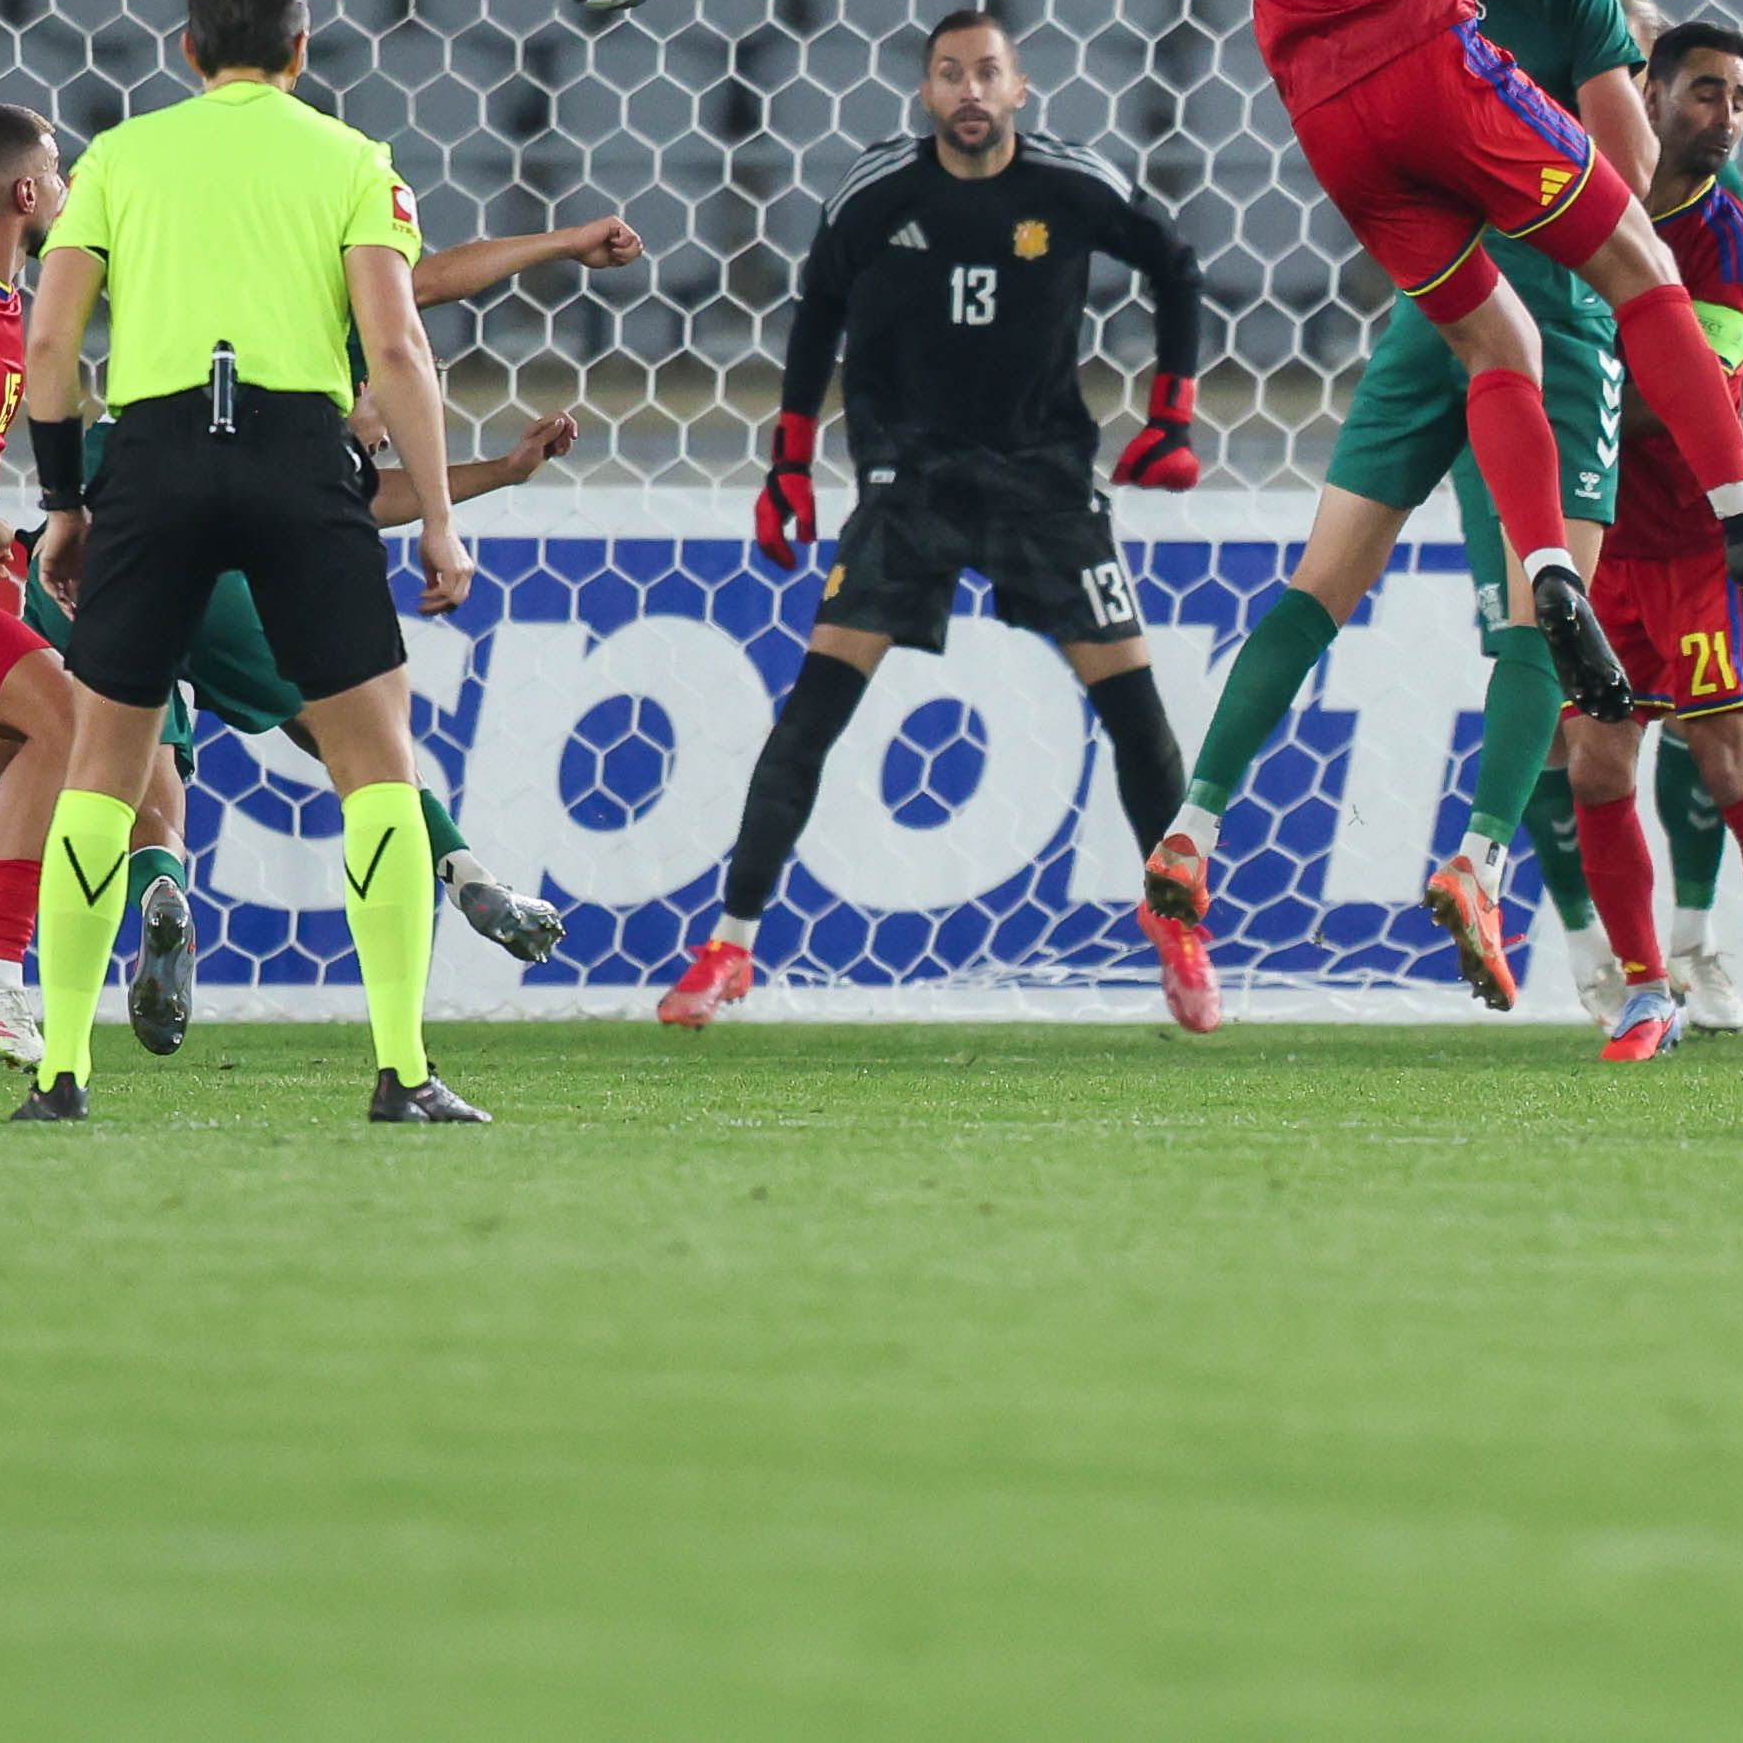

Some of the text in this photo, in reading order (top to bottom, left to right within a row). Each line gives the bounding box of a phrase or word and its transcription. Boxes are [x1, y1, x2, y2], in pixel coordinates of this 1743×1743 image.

[949, 266, 999, 326] 13
[1081, 560, 1134, 628] 13
[1680, 631, 1738, 697] 21
